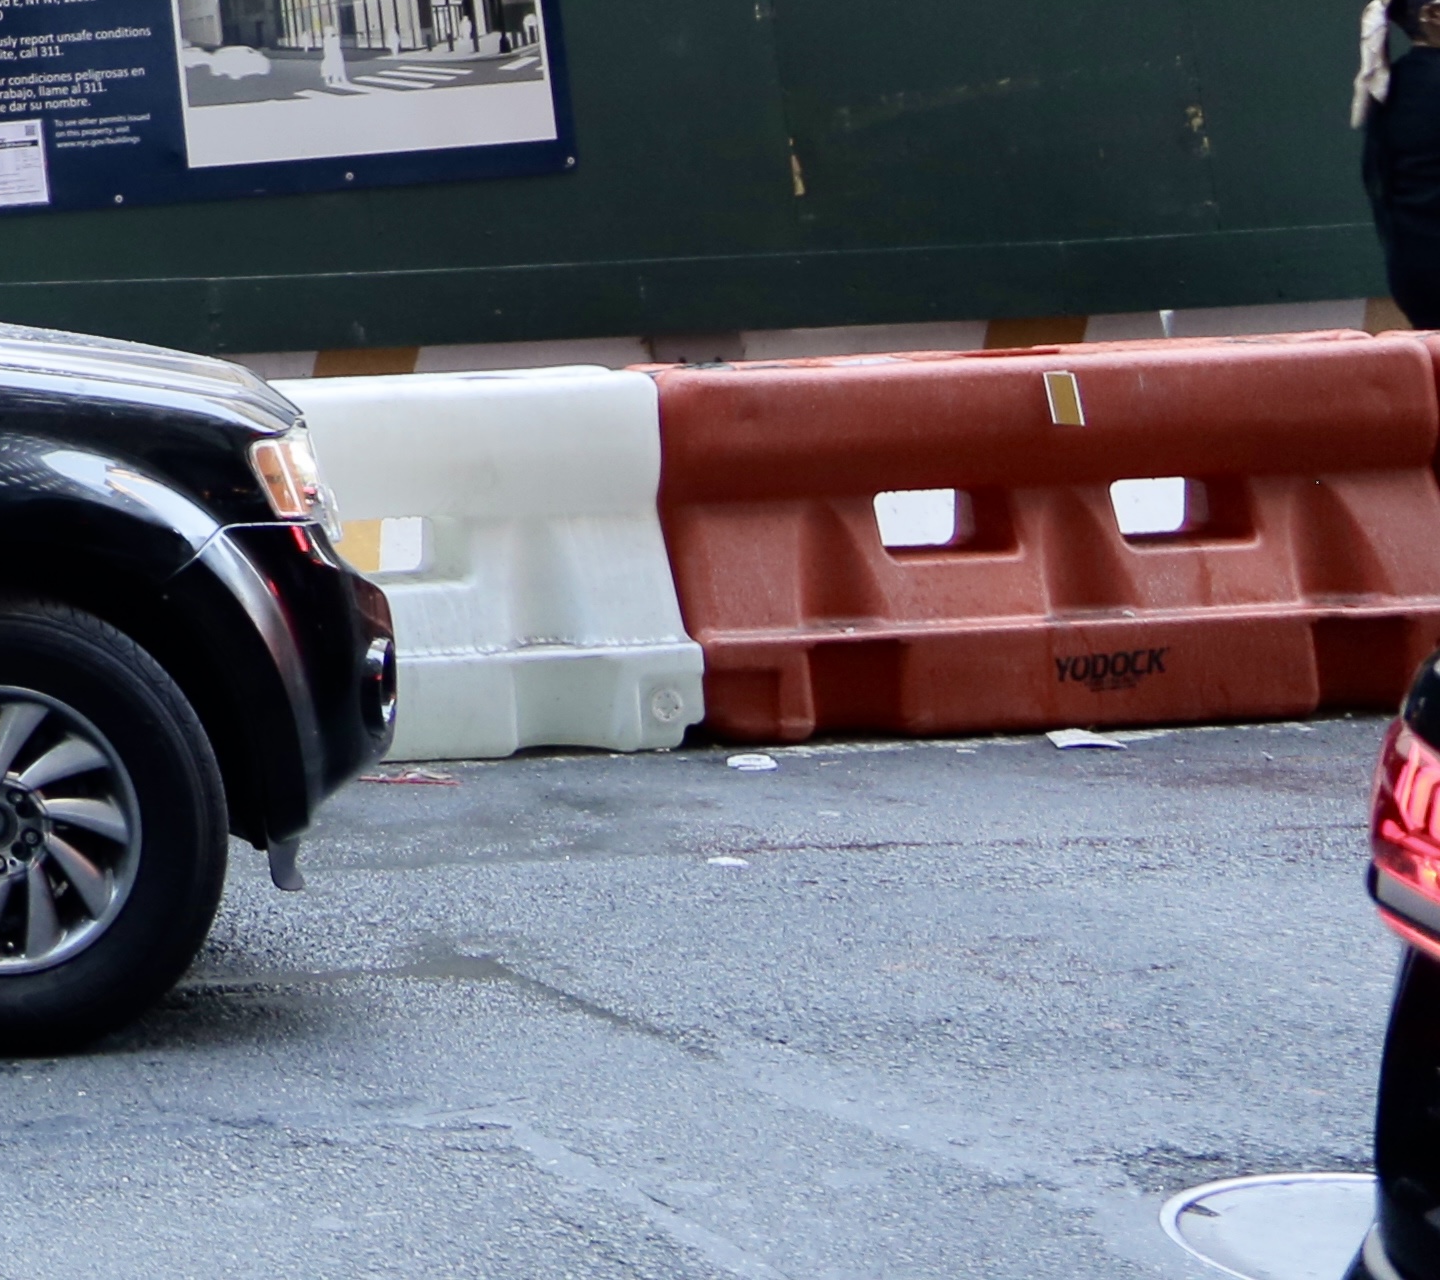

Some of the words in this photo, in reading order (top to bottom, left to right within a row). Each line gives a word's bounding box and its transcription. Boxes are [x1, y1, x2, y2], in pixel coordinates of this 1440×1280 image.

[20, 34, 54, 46] report
[57, 29, 93, 43] unsafe
[95, 26, 152, 40] conditions
[20, 47, 38, 58] call
[40, 45, 64, 57] 311.
[8, 72, 72, 86] condiciones
[74, 68, 129, 82] peligrosas
[131, 67, 145, 77] en
[38, 84, 69, 96] llame
[71, 82, 81, 95] al
[84, 81, 108, 94] 311.
[9, 101, 27, 112] dar
[30, 102, 43, 111] su
[45, 97, 91, 109] nombre.
[1055, 647, 1167, 682] YODOCK
